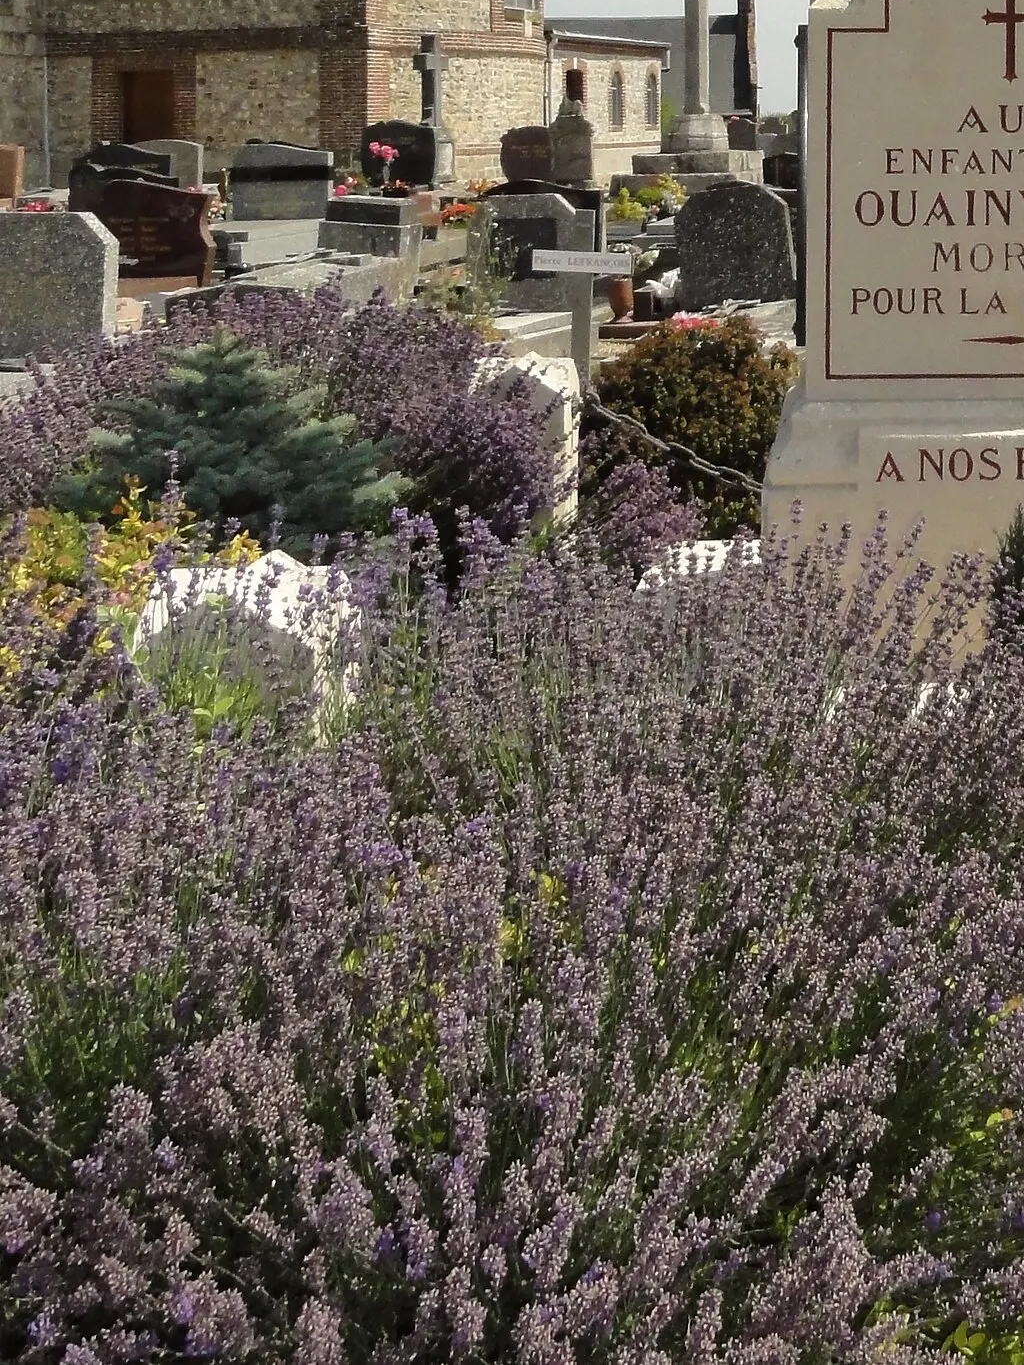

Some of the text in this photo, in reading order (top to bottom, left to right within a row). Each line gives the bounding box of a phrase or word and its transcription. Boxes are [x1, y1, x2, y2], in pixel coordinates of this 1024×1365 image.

[850, 287, 946, 315] POUR
[959, 287, 1008, 315] LA
[875, 450, 905, 482] A
[917, 447, 1002, 482] NOS
